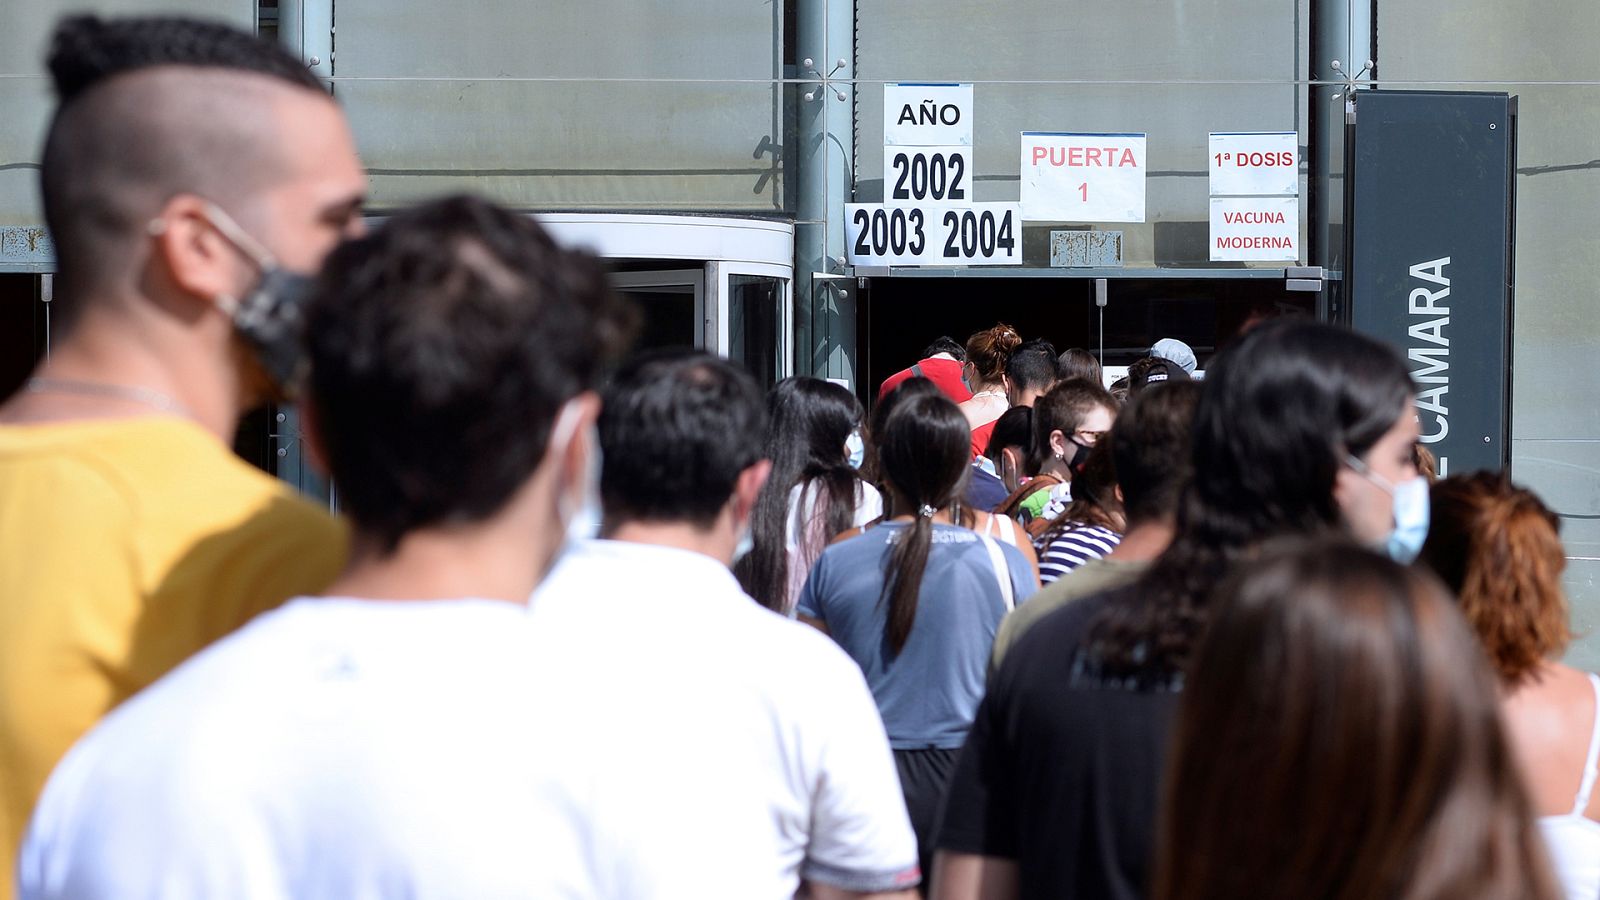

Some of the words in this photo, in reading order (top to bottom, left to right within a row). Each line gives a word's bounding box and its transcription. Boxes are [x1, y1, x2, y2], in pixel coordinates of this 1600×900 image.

[897, 99, 961, 126] AÑO
[1032, 146, 1137, 168] PUERTA
[1214, 152, 1231, 167] 1ª
[1236, 151, 1294, 167] DOSIS
[892, 153, 965, 201] 2002
[1078, 182, 1088, 202] 1
[1223, 211, 1286, 225] VACUNA
[853, 208, 926, 257] 2003
[942, 209, 1015, 258] 2004
[1216, 236, 1293, 250] MODERNA
